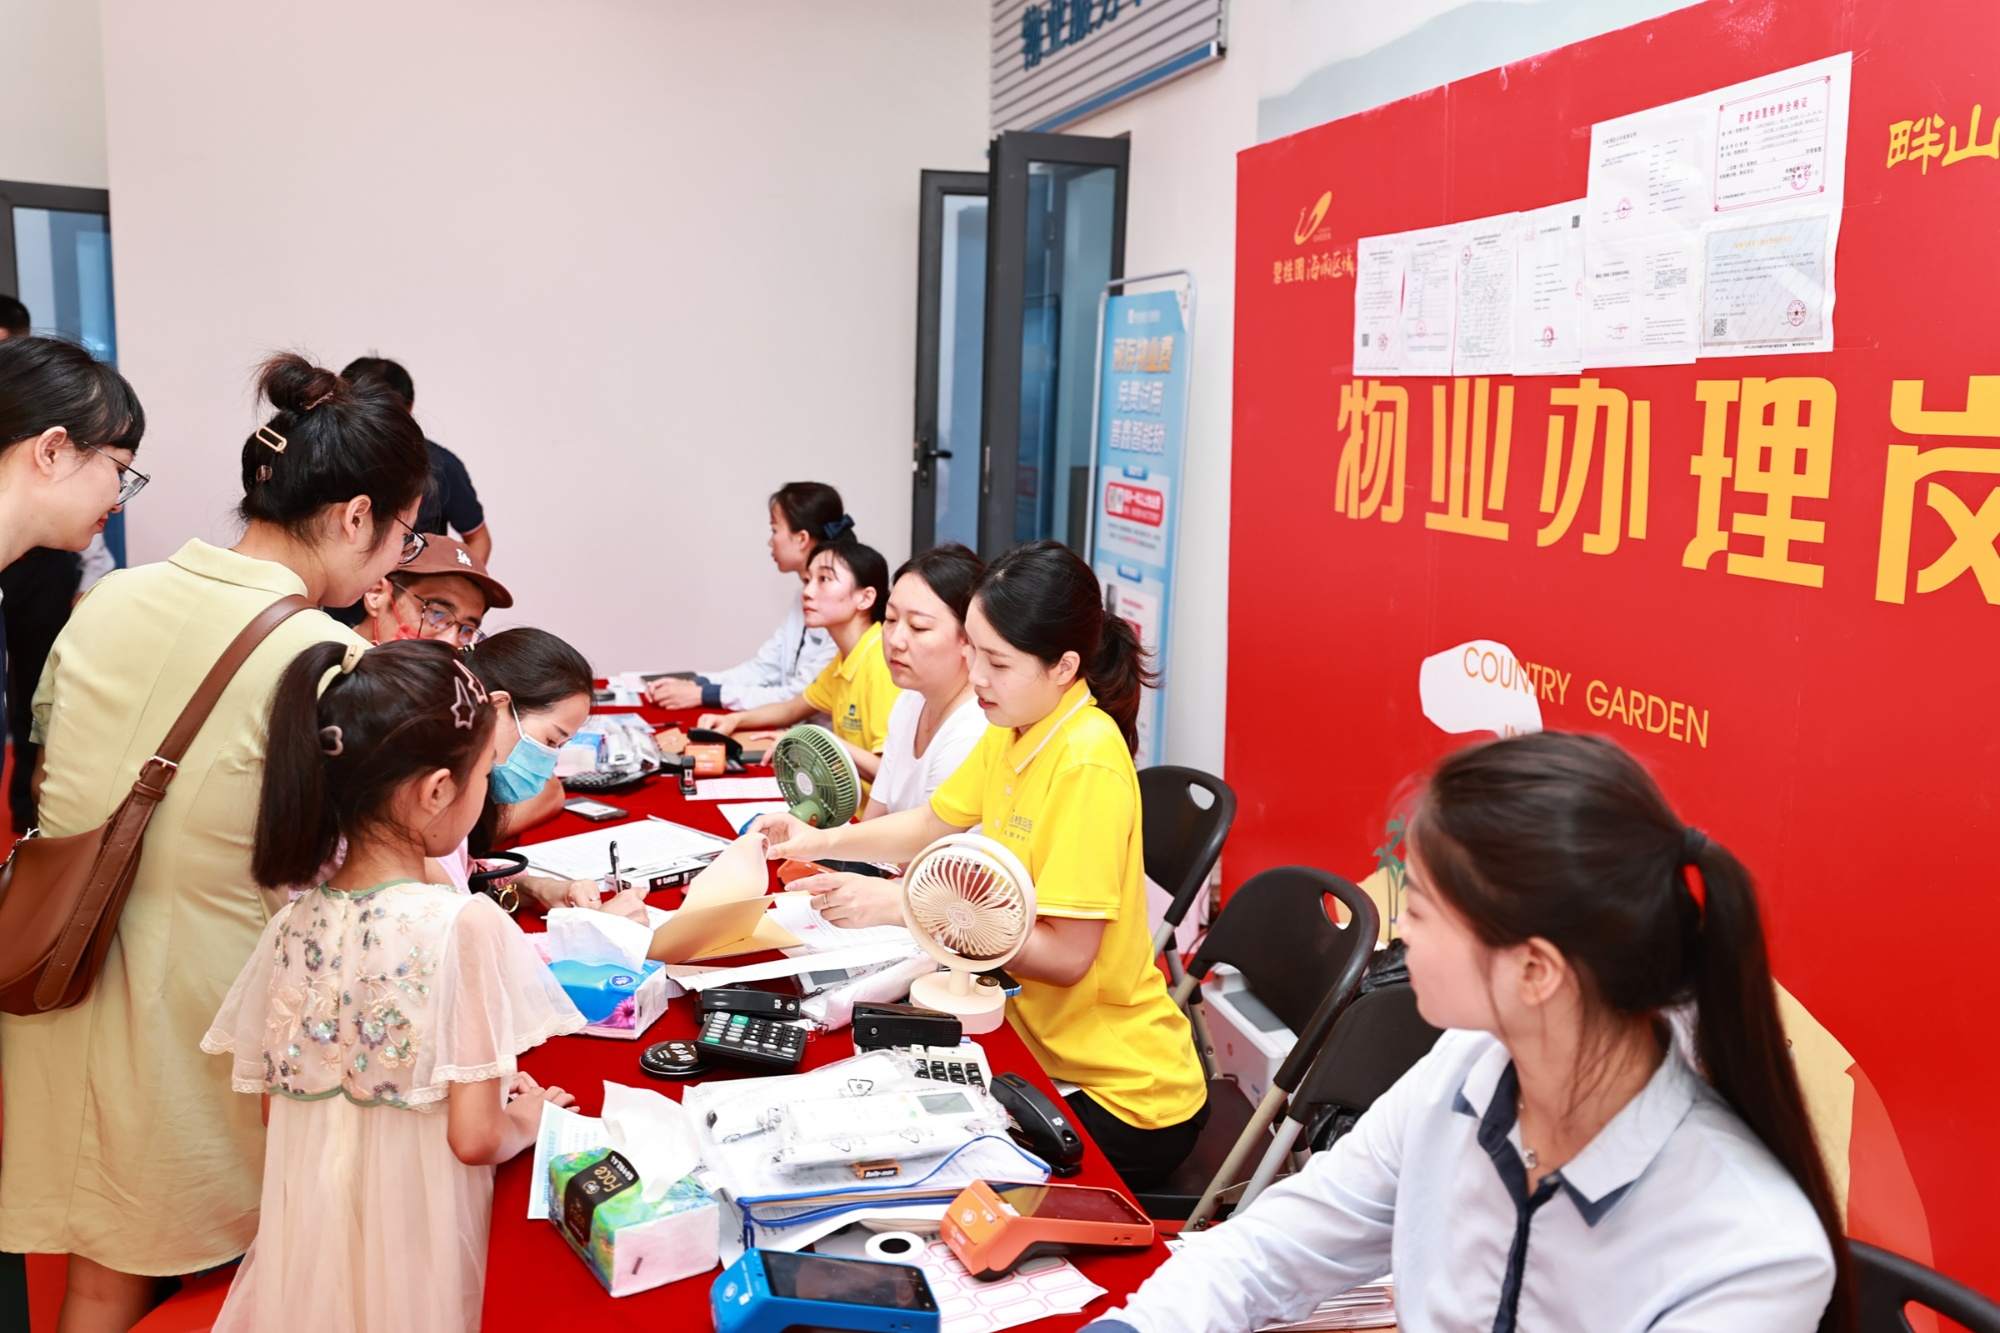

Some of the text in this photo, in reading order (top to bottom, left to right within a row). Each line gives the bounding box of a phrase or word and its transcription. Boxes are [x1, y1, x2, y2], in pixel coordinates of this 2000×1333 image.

[1886, 103, 2000, 176] 畔山
[1117, 380, 1164, 415] 免费试用
[1463, 646, 1709, 748] COUNTRY GARDEN
[594, 1165, 622, 1193] Face
